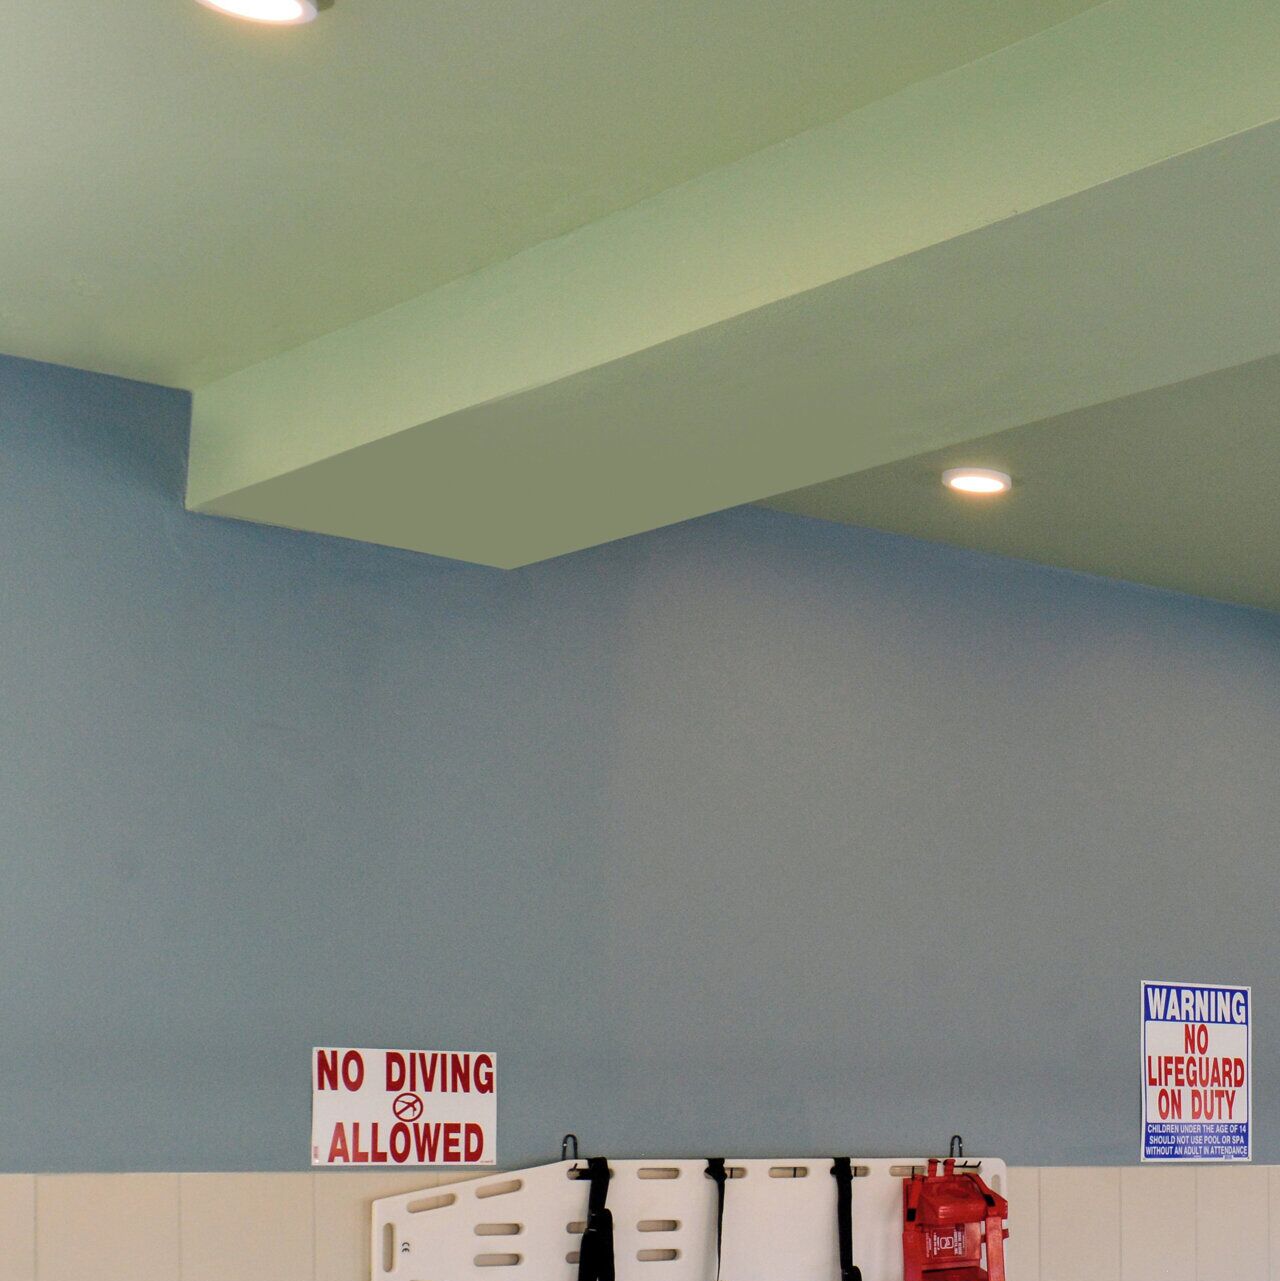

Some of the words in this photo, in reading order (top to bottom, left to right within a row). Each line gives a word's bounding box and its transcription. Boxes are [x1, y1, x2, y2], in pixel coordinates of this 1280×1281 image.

[1147, 987, 1245, 1024] WARNING
[1184, 1024, 1209, 1055] NO
[317, 1050, 364, 1092] NO
[386, 1052, 494, 1094] DIVING
[1147, 1055, 1244, 1088] LIFEGUARD
[1158, 1089, 1181, 1120] ON
[1191, 1089, 1236, 1120] DUTY
[328, 1122, 484, 1163] ALLOWED
[1147, 1124, 1179, 1133] CHILDREN
[1180, 1124, 1201, 1133] UNDER
[1202, 1124, 1215, 1133] THE
[1215, 1125, 1229, 1133] AGE
[1229, 1125, 1238, 1133] OF
[1239, 1125, 1246, 1133] 14
[1149, 1135, 1175, 1144] SHOULD
[1176, 1135, 1190, 1144] NOT
[1190, 1135, 1203, 1144] USE
[1203, 1135, 1221, 1144] POOL
[1221, 1136, 1231, 1144] OR
[1231, 1136, 1244, 1144] SPA
[1146, 1146, 1174, 1155] WITHOUT
[1174, 1146, 1183, 1155] AN
[1183, 1146, 1202, 1155] ADULT
[1203, 1146, 1209, 1155] IN
[1210, 1146, 1247, 1155] ATTENDANCE
